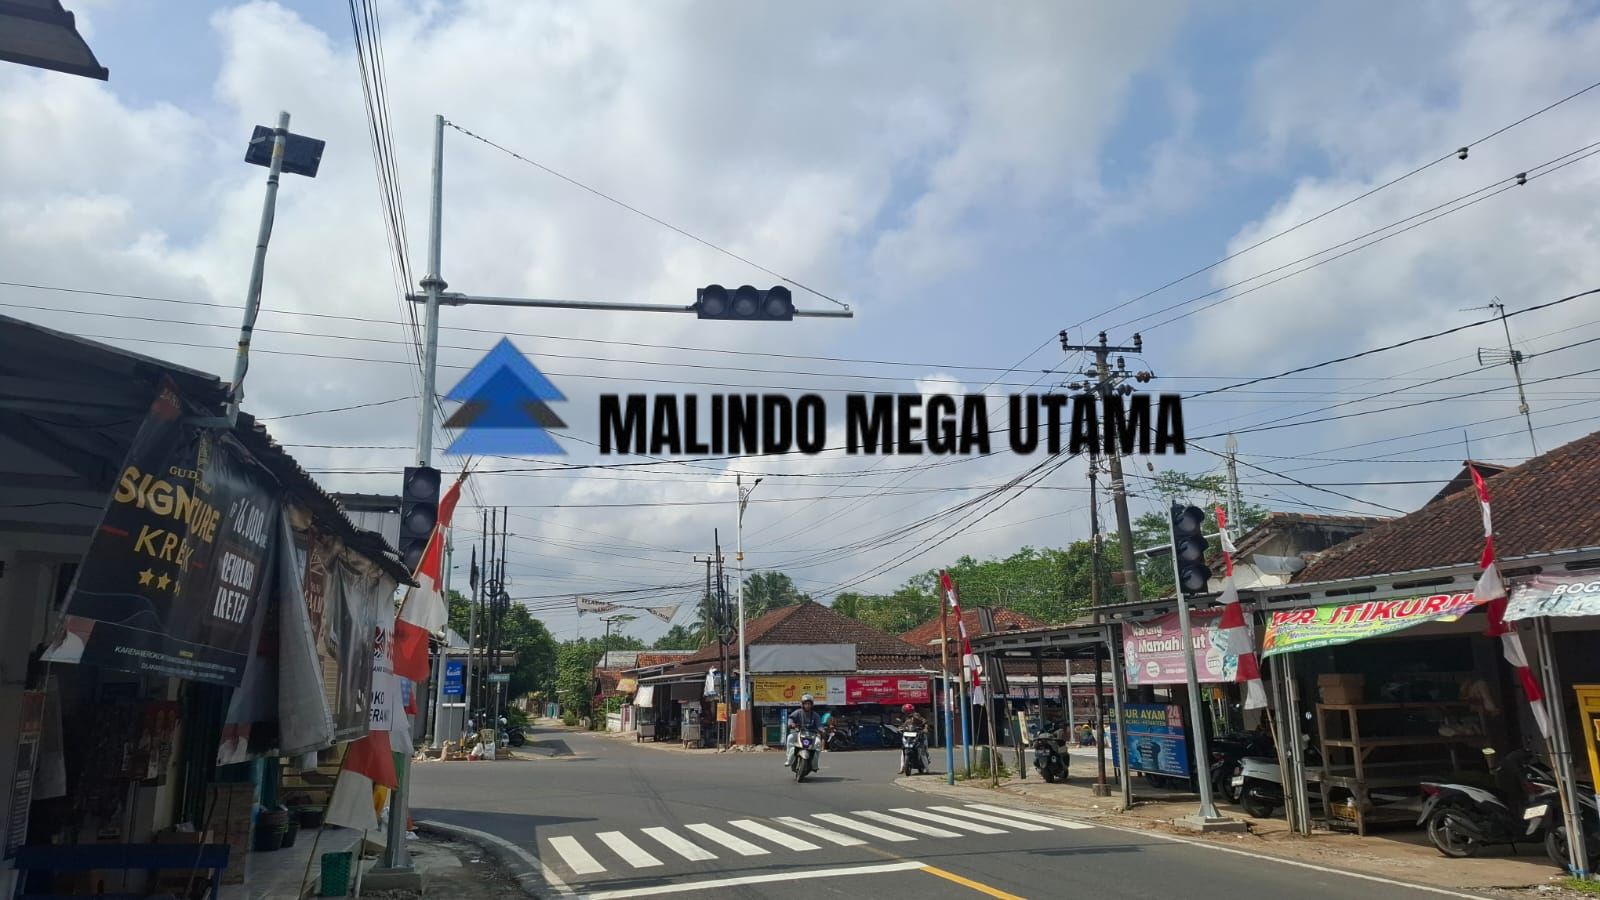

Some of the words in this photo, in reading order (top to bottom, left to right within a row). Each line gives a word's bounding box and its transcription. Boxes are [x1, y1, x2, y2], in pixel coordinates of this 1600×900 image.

[1552, 581, 1600, 596] BOG
[1137, 636, 1180, 653] Mamah
[1141, 709, 1166, 721] AYAM
[1167, 704, 1180, 719] 24
